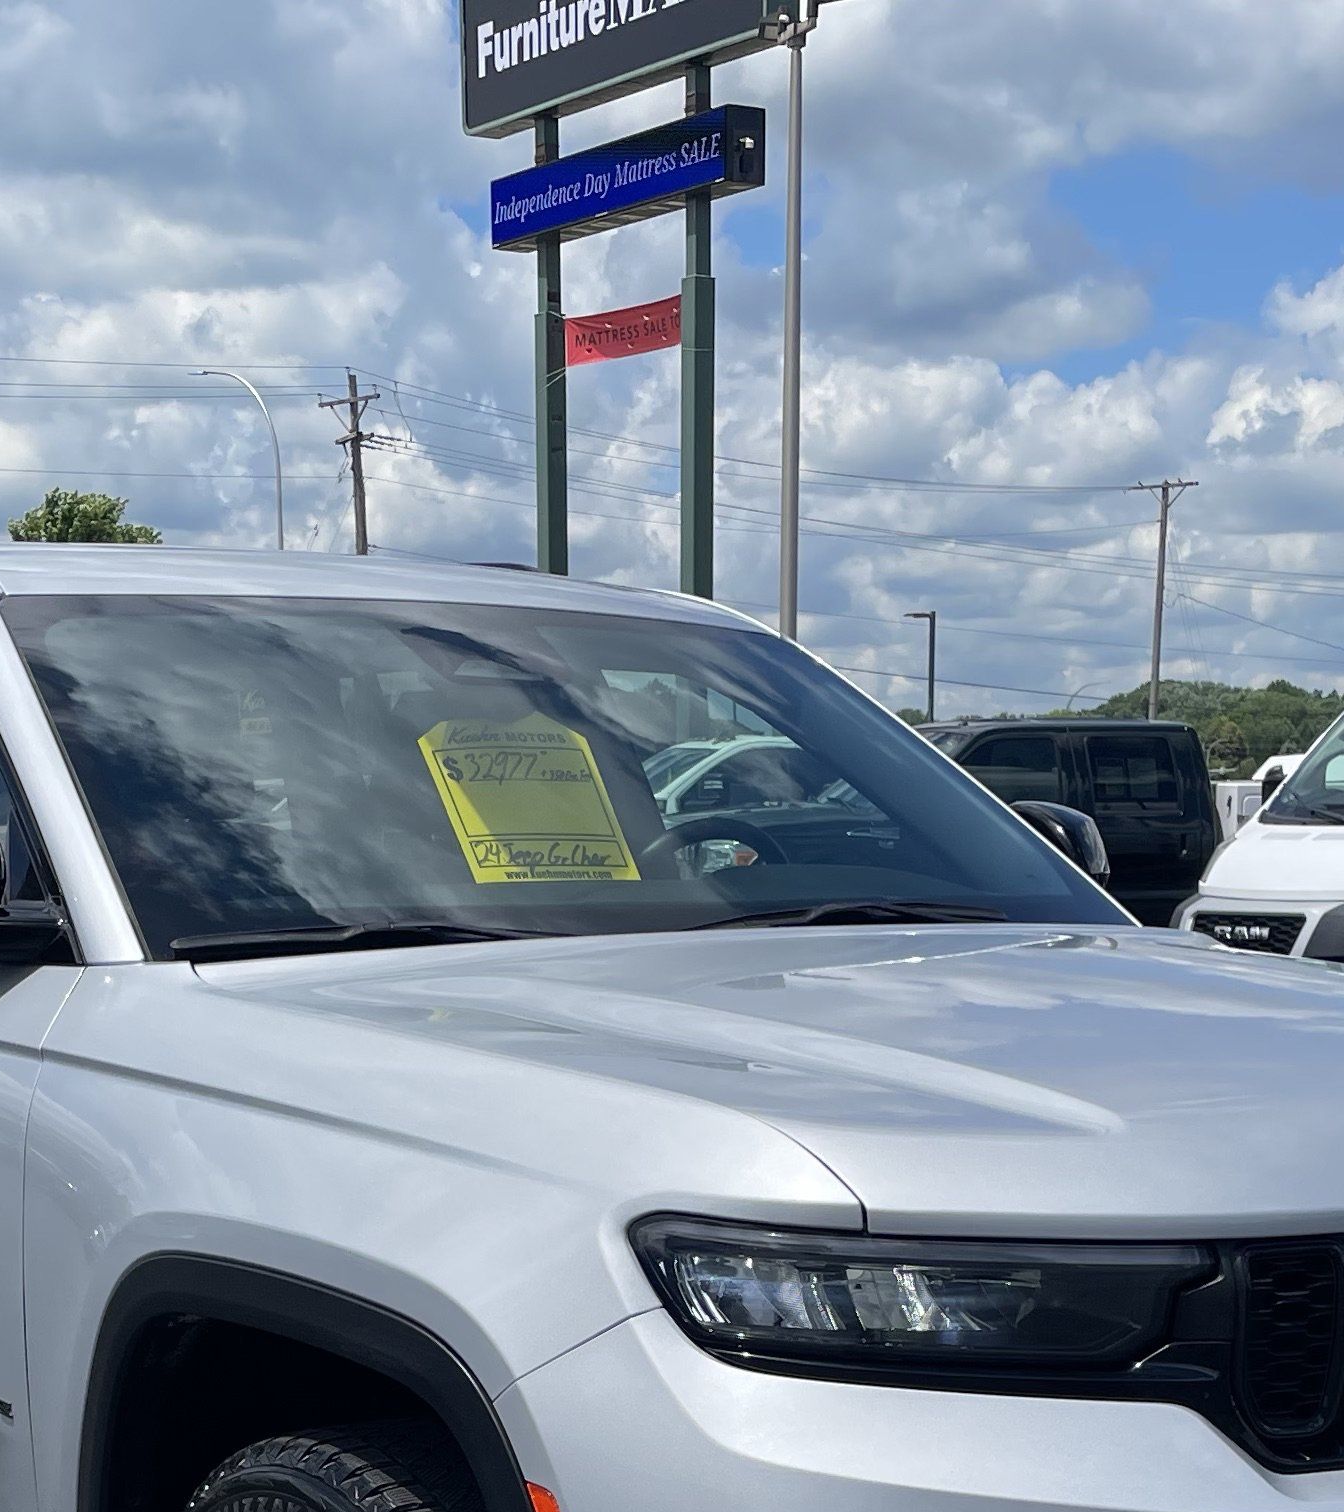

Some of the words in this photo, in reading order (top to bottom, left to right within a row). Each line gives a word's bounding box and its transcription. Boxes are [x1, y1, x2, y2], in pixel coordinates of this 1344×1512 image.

[494, 182, 581, 225] Independence
[583, 171, 610, 199] Day
[614, 151, 677, 188] Mattress
[680, 132, 721, 168] SALE
[575, 325, 640, 348] MATTRESS
[643, 317, 668, 337] SALE
[501, 732, 567, 744] MOTORS
[1214, 925, 1270, 940] RAM
